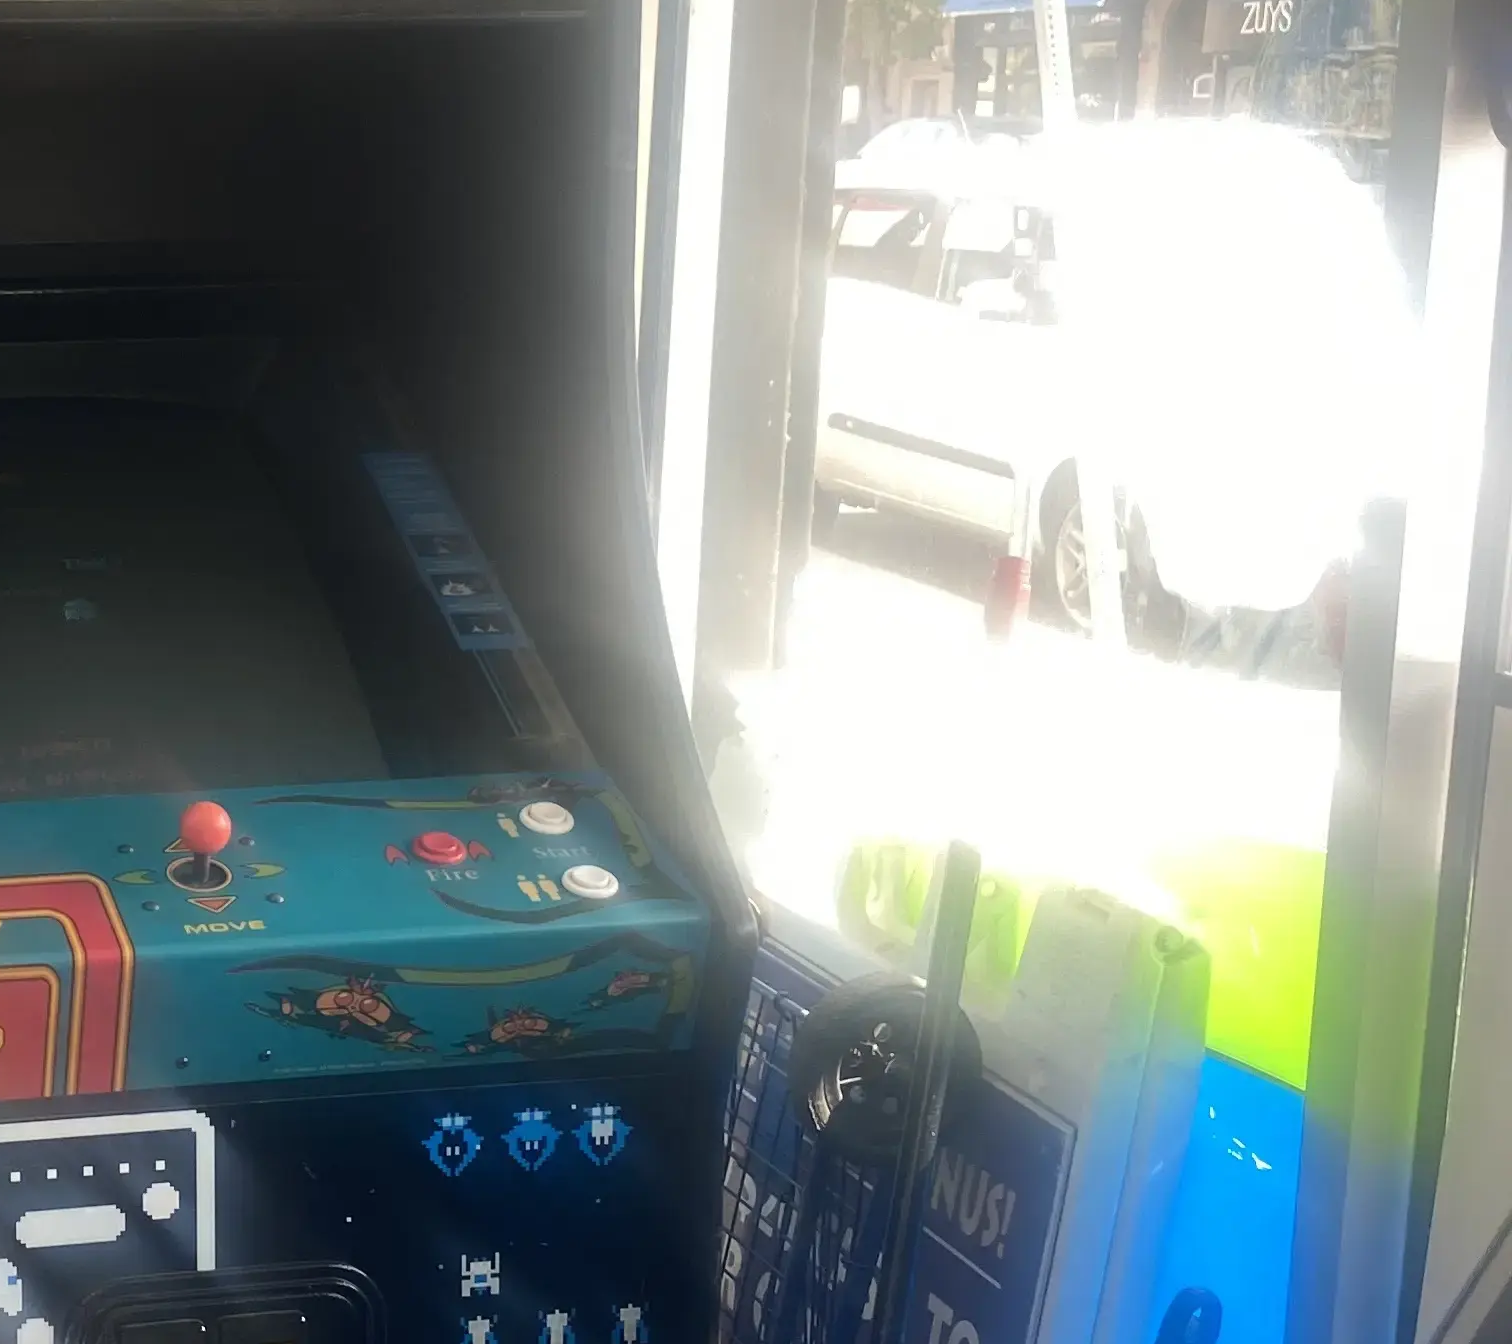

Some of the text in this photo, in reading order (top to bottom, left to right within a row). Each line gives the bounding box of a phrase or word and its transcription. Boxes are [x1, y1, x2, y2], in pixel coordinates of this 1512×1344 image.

[1239, 0, 1294, 34] ZUYS
[532, 845, 593, 860] Start
[425, 868, 480, 883] Fire
[183, 919, 267, 935] MOVE
